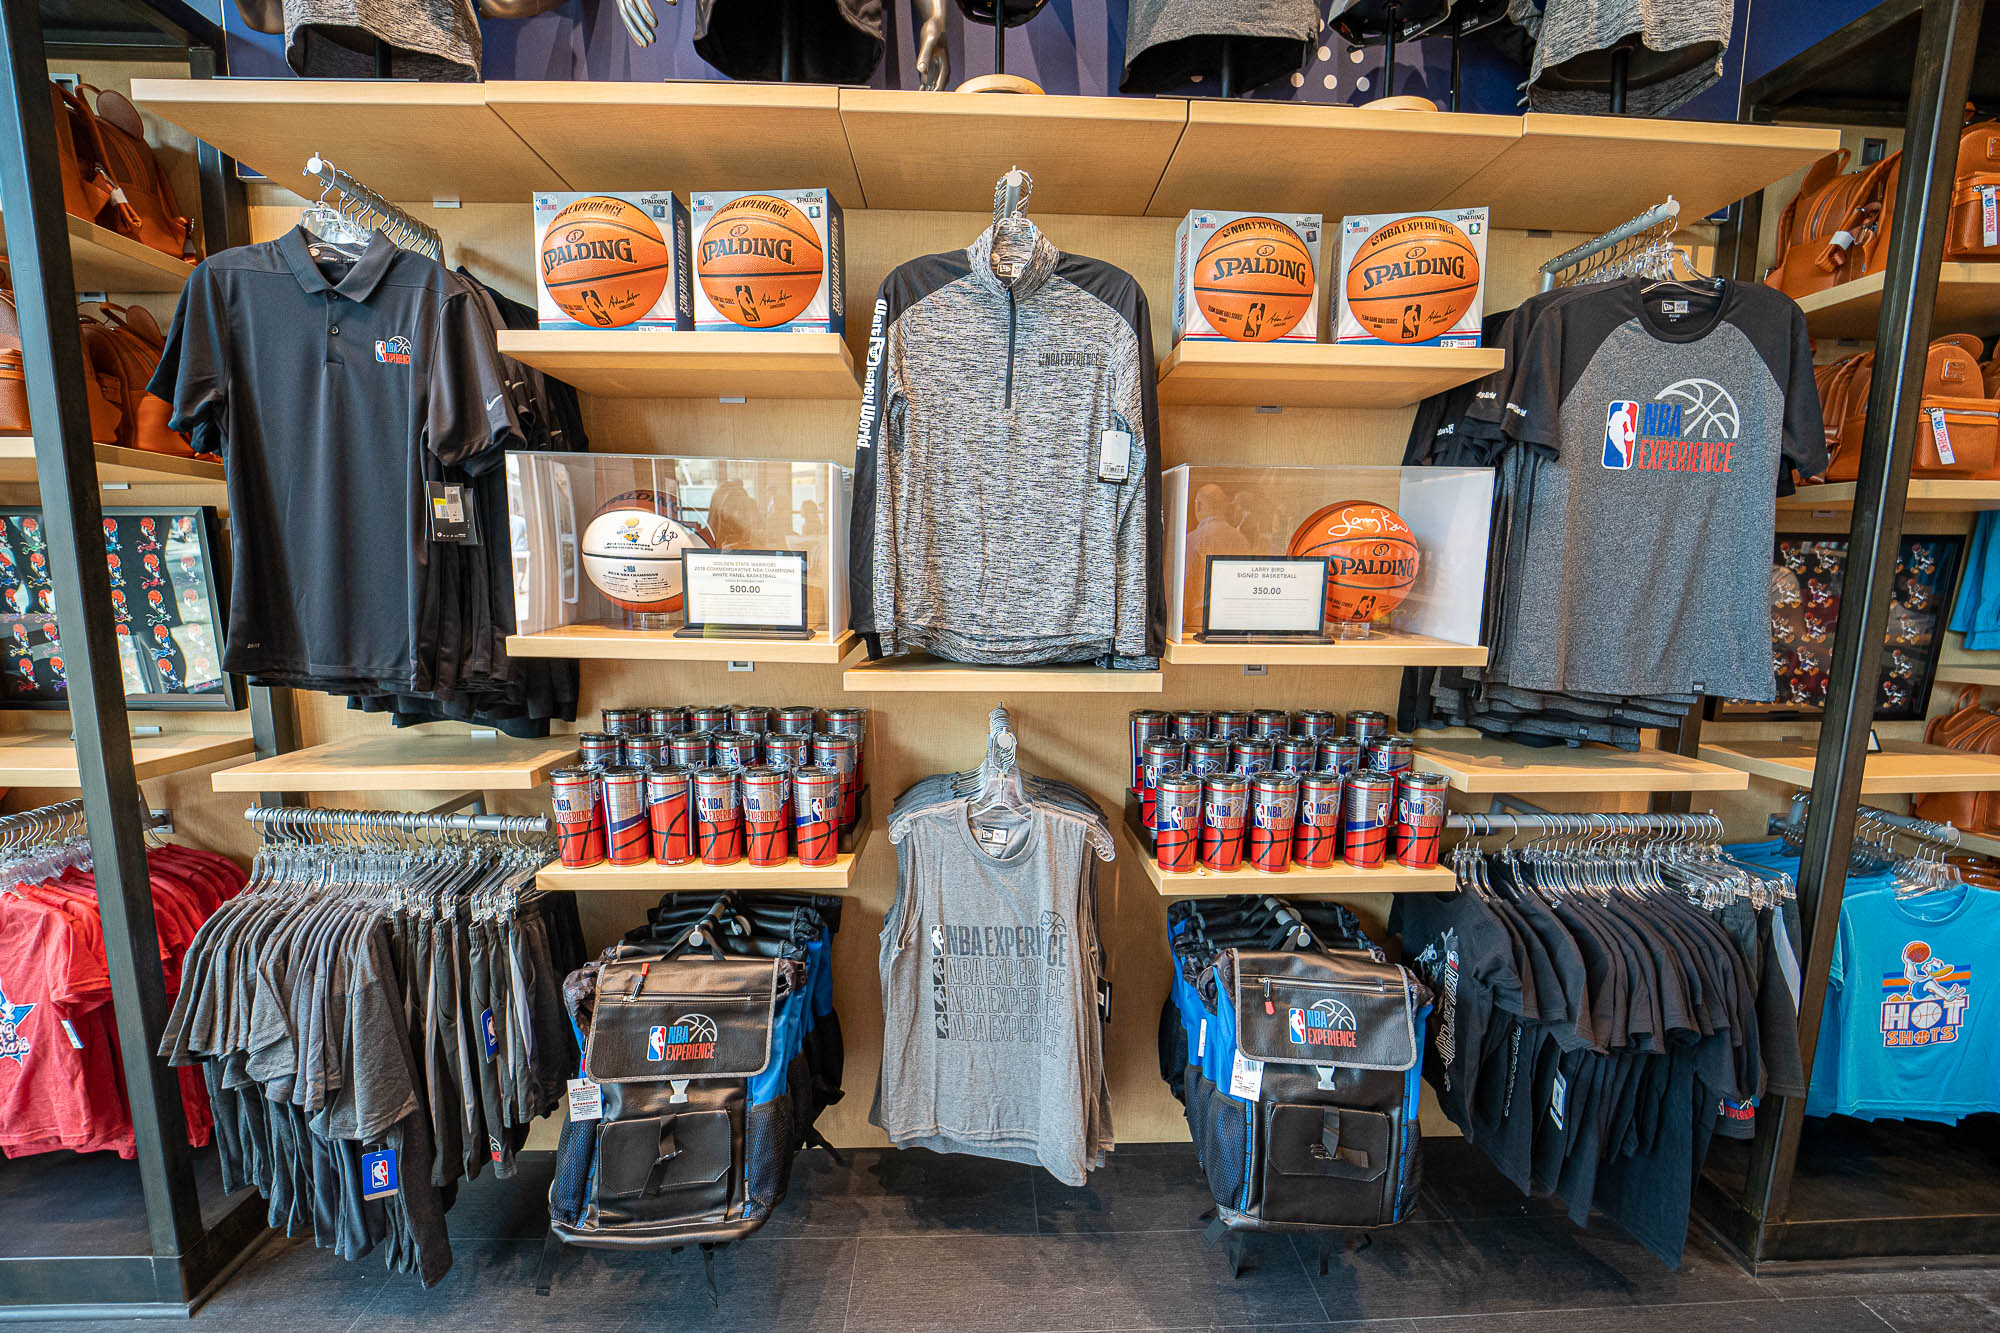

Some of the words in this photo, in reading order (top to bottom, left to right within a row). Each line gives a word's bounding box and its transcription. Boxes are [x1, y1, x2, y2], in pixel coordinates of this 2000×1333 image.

[568, 201, 624, 217] EXPERIENCE
[734, 200, 791, 219] EXPERIENCE
[797, 196, 823, 204] SPALDING
[1296, 221, 1320, 229] SPALDING
[1457, 213, 1484, 222] SPALDING
[1230, 221, 1252, 235] NBA
[1379, 225, 1401, 241] NBA
[543, 238, 634, 276] SPALDING
[703, 238, 793, 266] SPALDING
[1213, 257, 1306, 287] SPALDING
[1363, 256, 1466, 291] SPALDING
[871, 298, 888, 337] Walt
[1046, 353, 1060, 366] NBA
[1061, 352, 1099, 367] EXPERIENCE
[858, 404, 877, 448] World
[1642, 403, 1683, 438] NBA
[1638, 440, 1736, 473] EXPERIENCE
[1329, 555, 1415, 577] SPALDING
[730, 585, 761, 593] 500.00
[1252, 587, 1282, 595] 350.00
[557, 799, 572, 811] NBA
[708, 797, 723, 810] NBA
[748, 798, 760, 811] NBA
[1217, 804, 1231, 817] NBA
[1267, 806, 1282, 818] NBA
[1316, 803, 1330, 815] NBA
[1410, 802, 1424, 814] NBA
[945, 925, 983, 956] NBA
[947, 957, 984, 985] NBA
[948, 986, 986, 1013] NBA
[1306, 1010, 1328, 1028] NBA
[1883, 998, 1967, 1030] HOT
[667, 1025, 689, 1044] NBA
[950, 1014, 988, 1042] NBA
[1887, 1026, 1955, 1045] SHOTS
[1307, 1028, 1358, 1048] EXPERIENCE
[665, 1042, 716, 1061] EXPERIENCE
